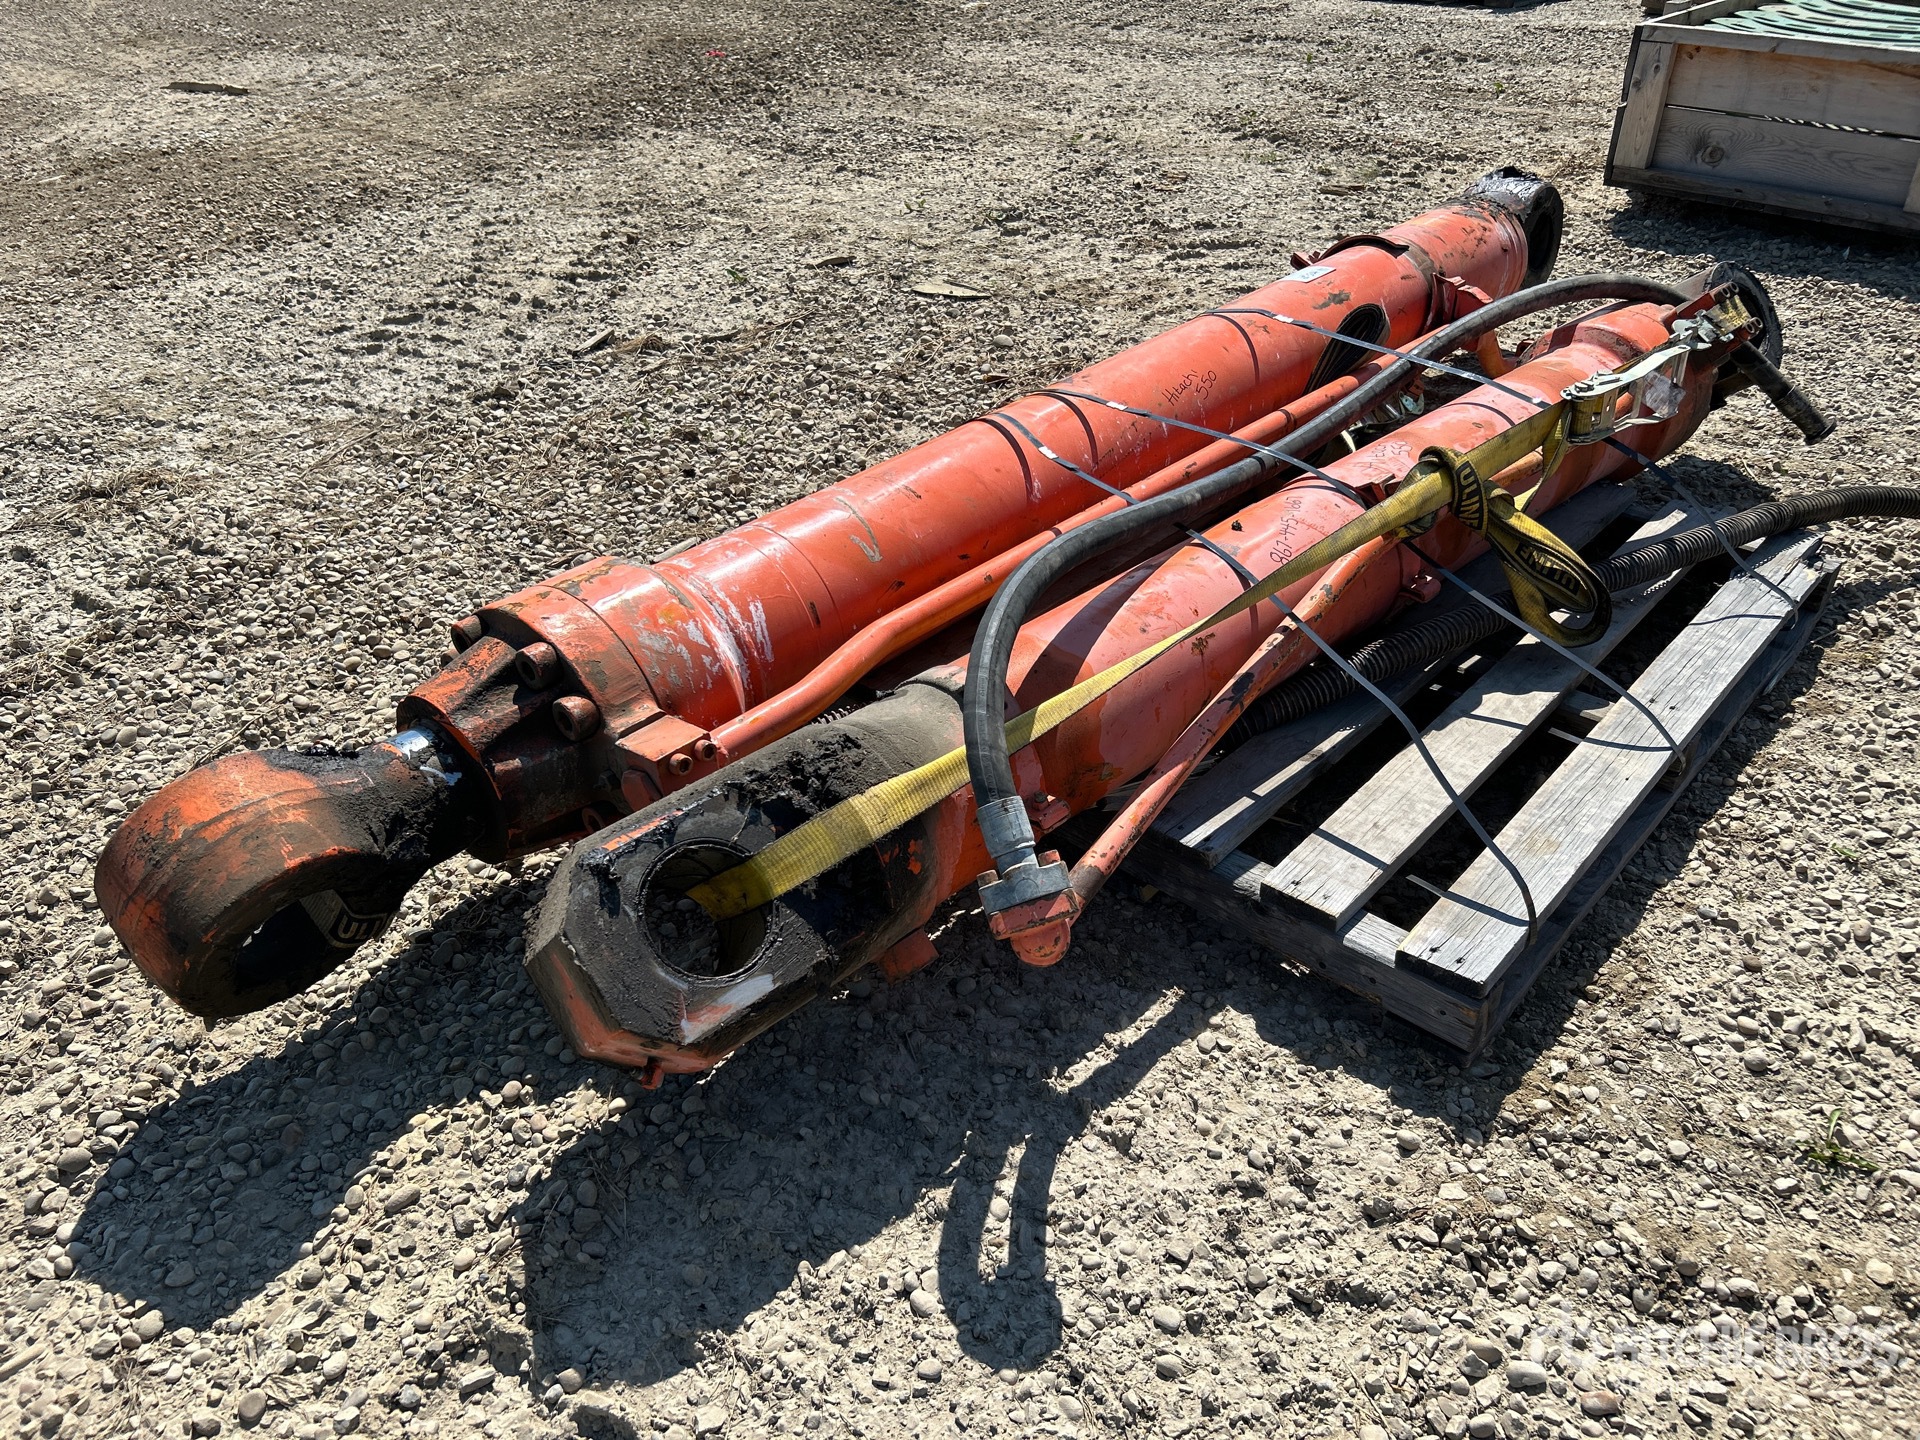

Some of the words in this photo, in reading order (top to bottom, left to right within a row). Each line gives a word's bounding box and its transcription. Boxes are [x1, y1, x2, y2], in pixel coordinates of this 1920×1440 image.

[1161, 369, 1198, 406] Hitachi
[1195, 370, 1217, 400] 550
[1459, 466, 1480, 528] ULINE
